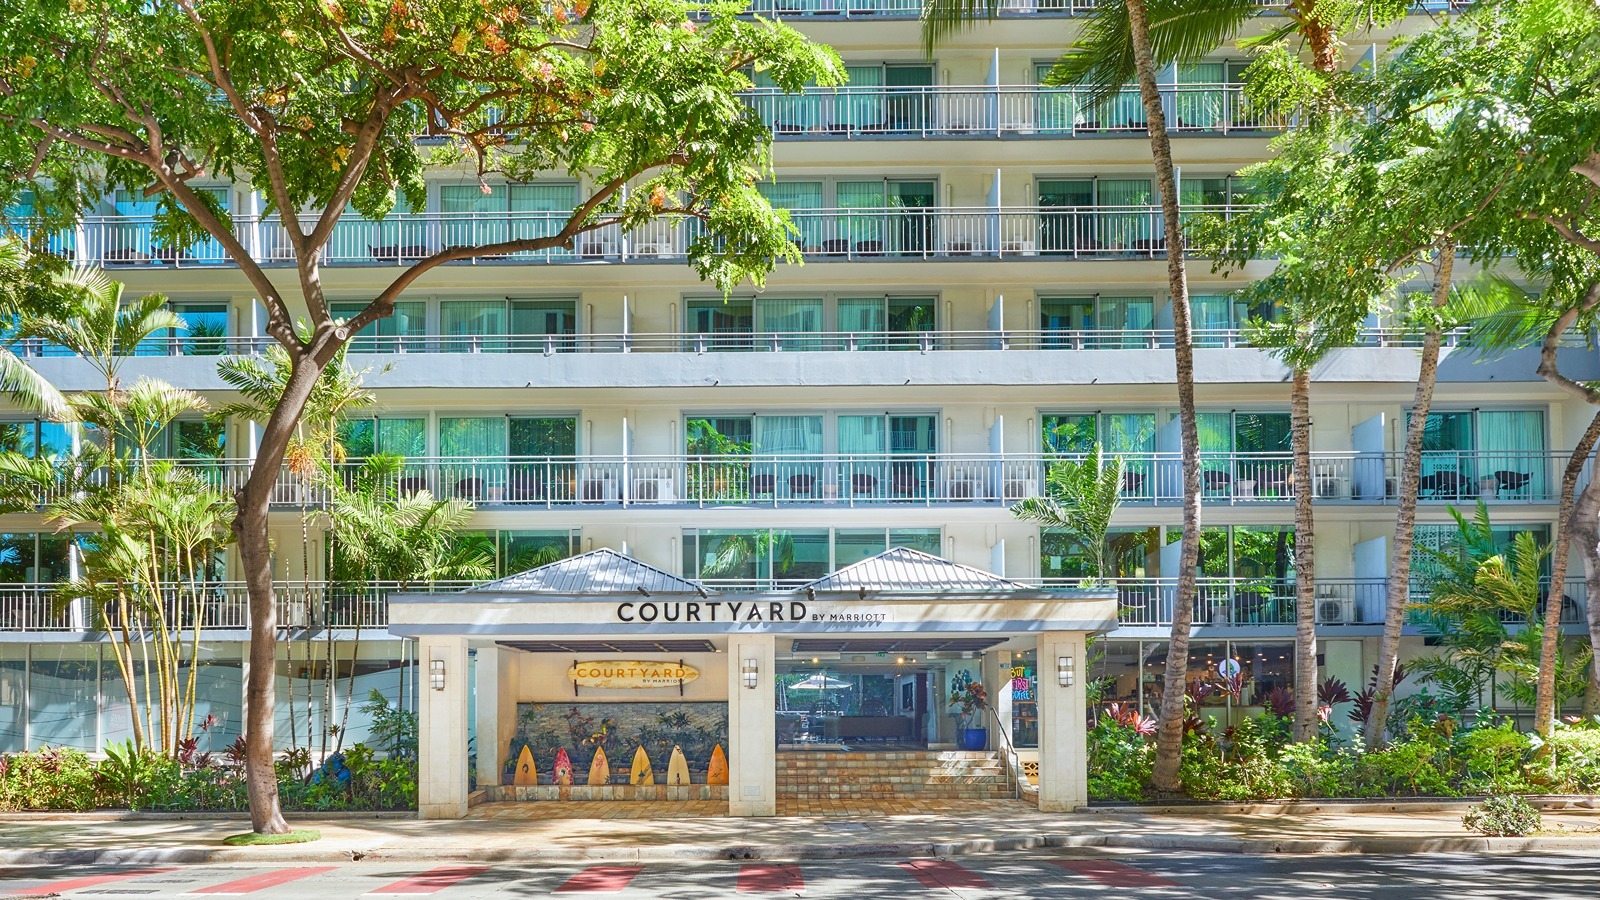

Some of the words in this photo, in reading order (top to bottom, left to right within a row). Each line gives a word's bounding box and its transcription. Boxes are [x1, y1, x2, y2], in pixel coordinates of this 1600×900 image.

[617, 602, 807, 621] COURTYARD
[812, 613, 825, 621] BY
[830, 613, 887, 621] MARRIOTT
[577, 668, 686, 678] COURTYARD
[1010, 667, 1025, 678] BUT
